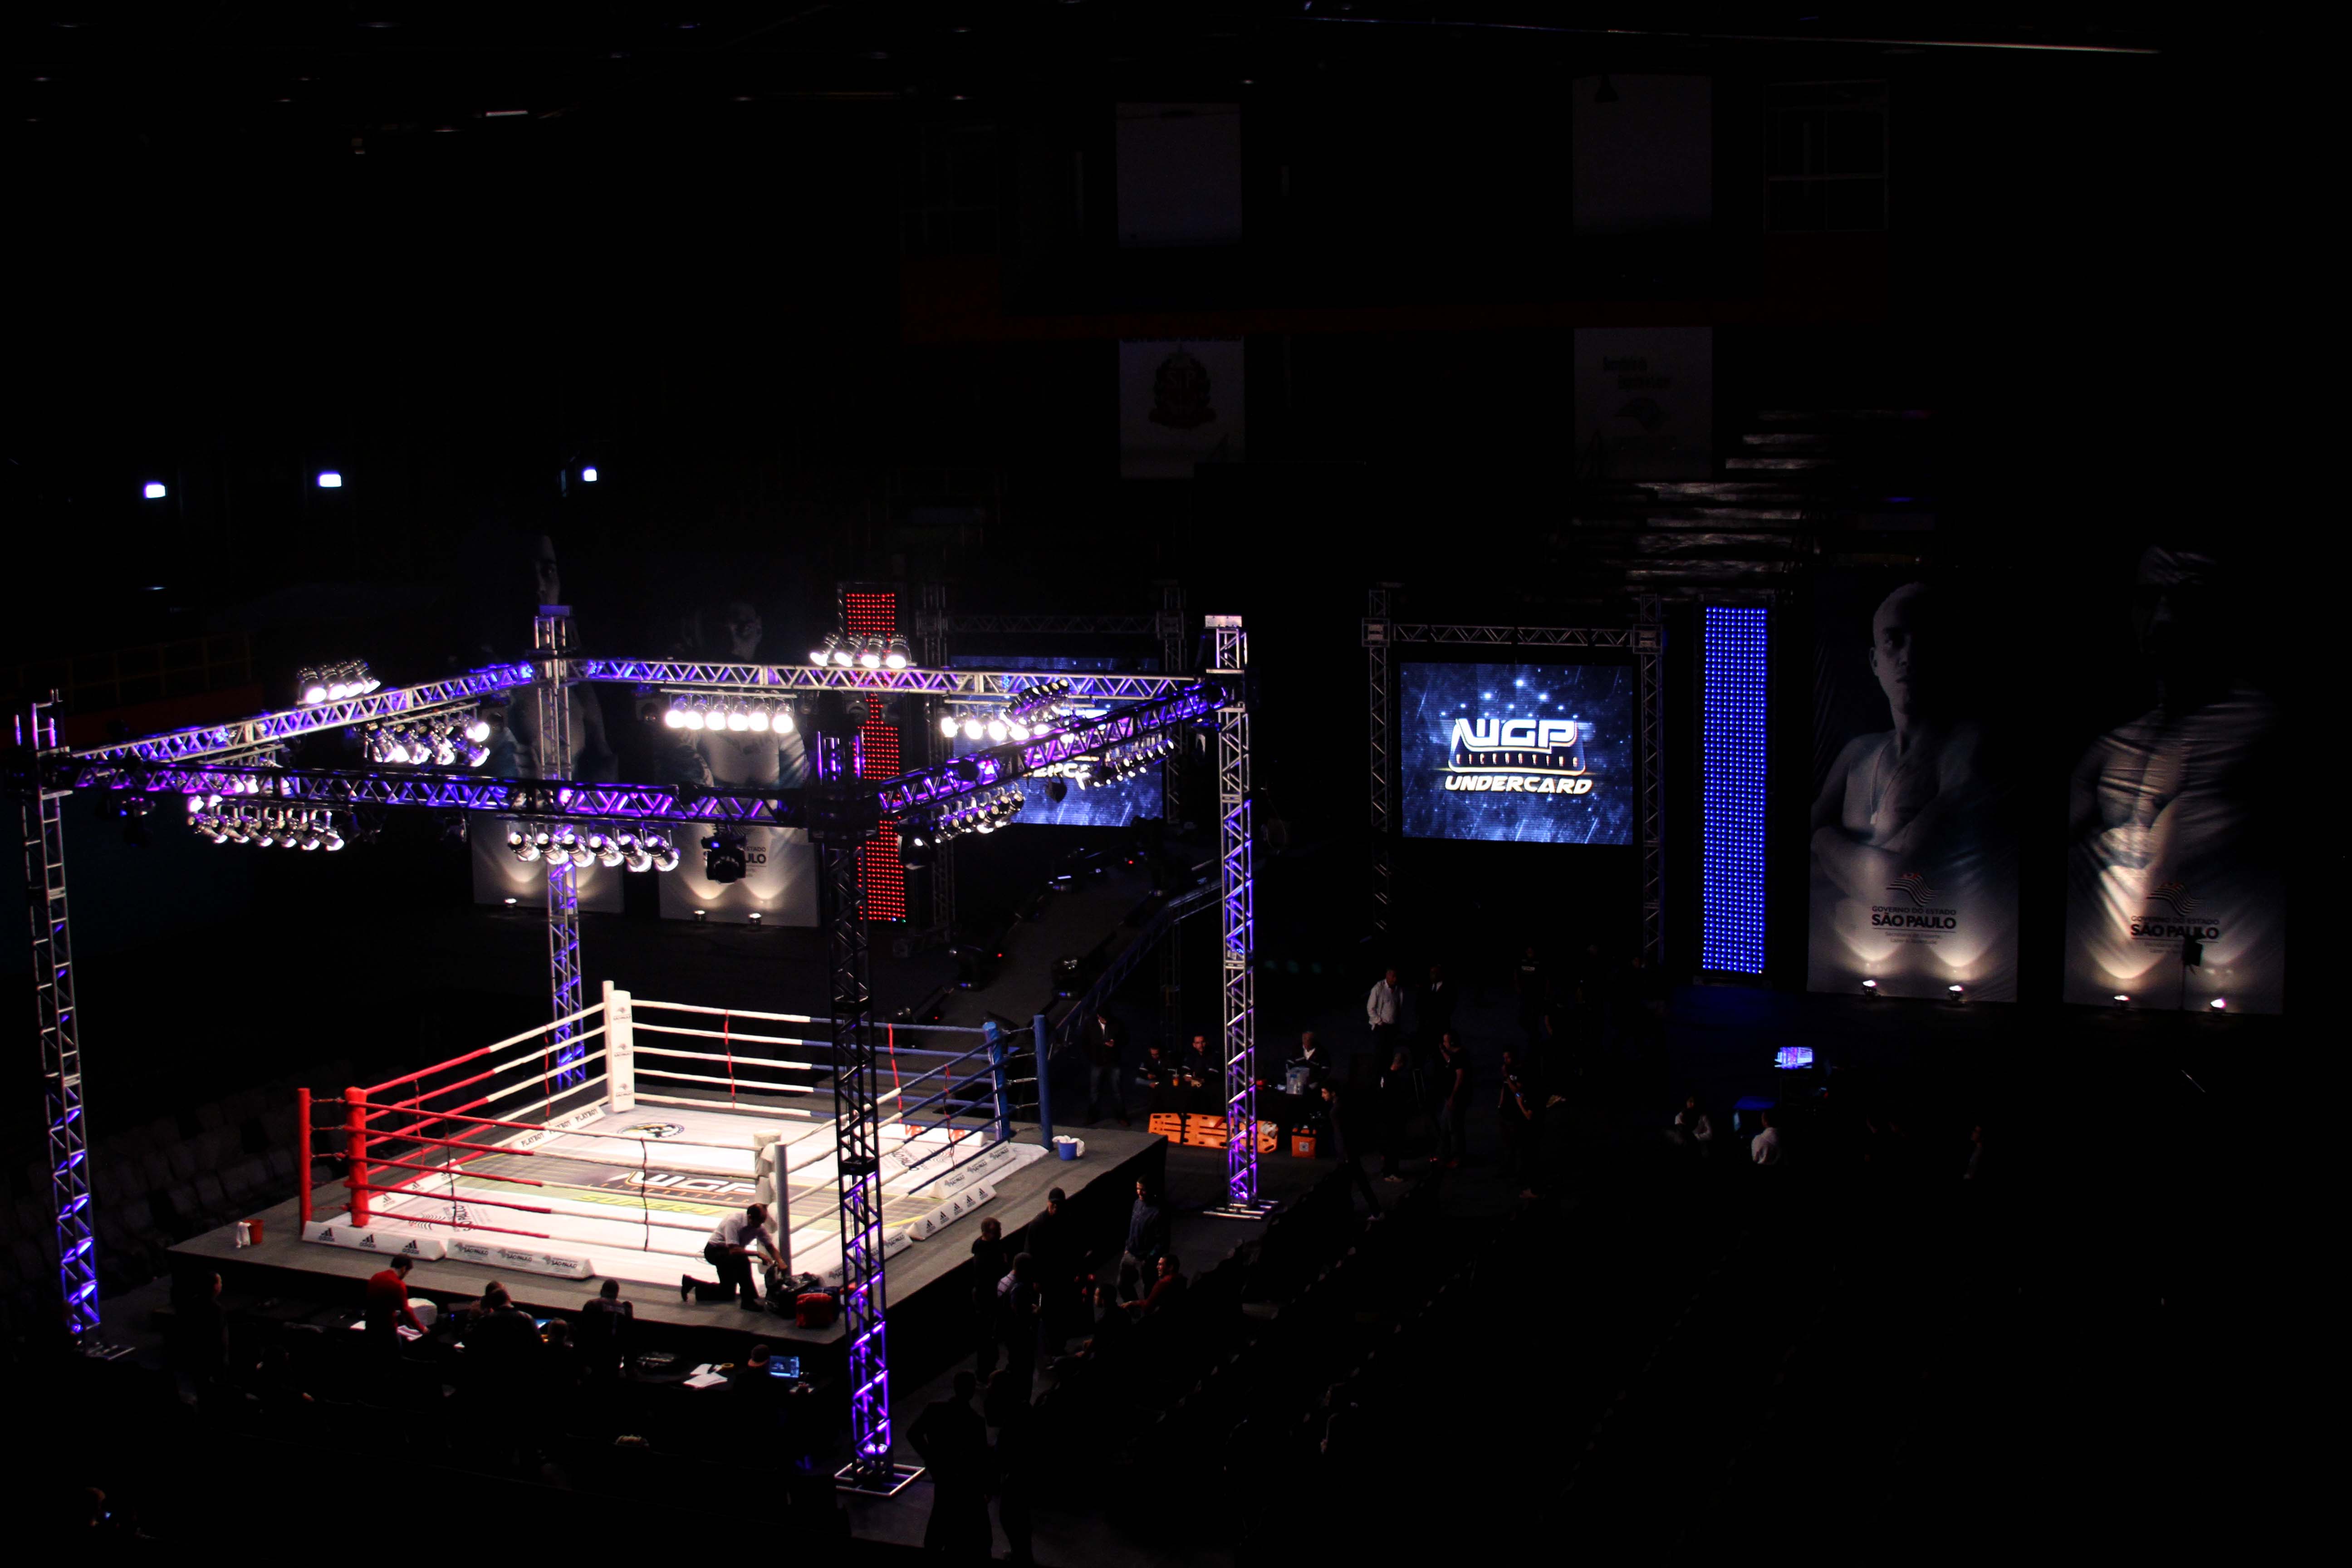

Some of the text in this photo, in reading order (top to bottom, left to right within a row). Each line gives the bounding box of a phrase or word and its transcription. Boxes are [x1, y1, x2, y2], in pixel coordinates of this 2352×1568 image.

[1452, 719, 1578, 749] WGP
[1444, 775, 1593, 794] UNDERCARD
[1872, 906, 1910, 914] GOVERNO
[1872, 912, 1956, 929] SÃO PAULO
[2168, 925, 2219, 939] PAULO
[575, 1108, 599, 1122] PLAYBOY
[521, 1132, 545, 1147] PLAYBOY
